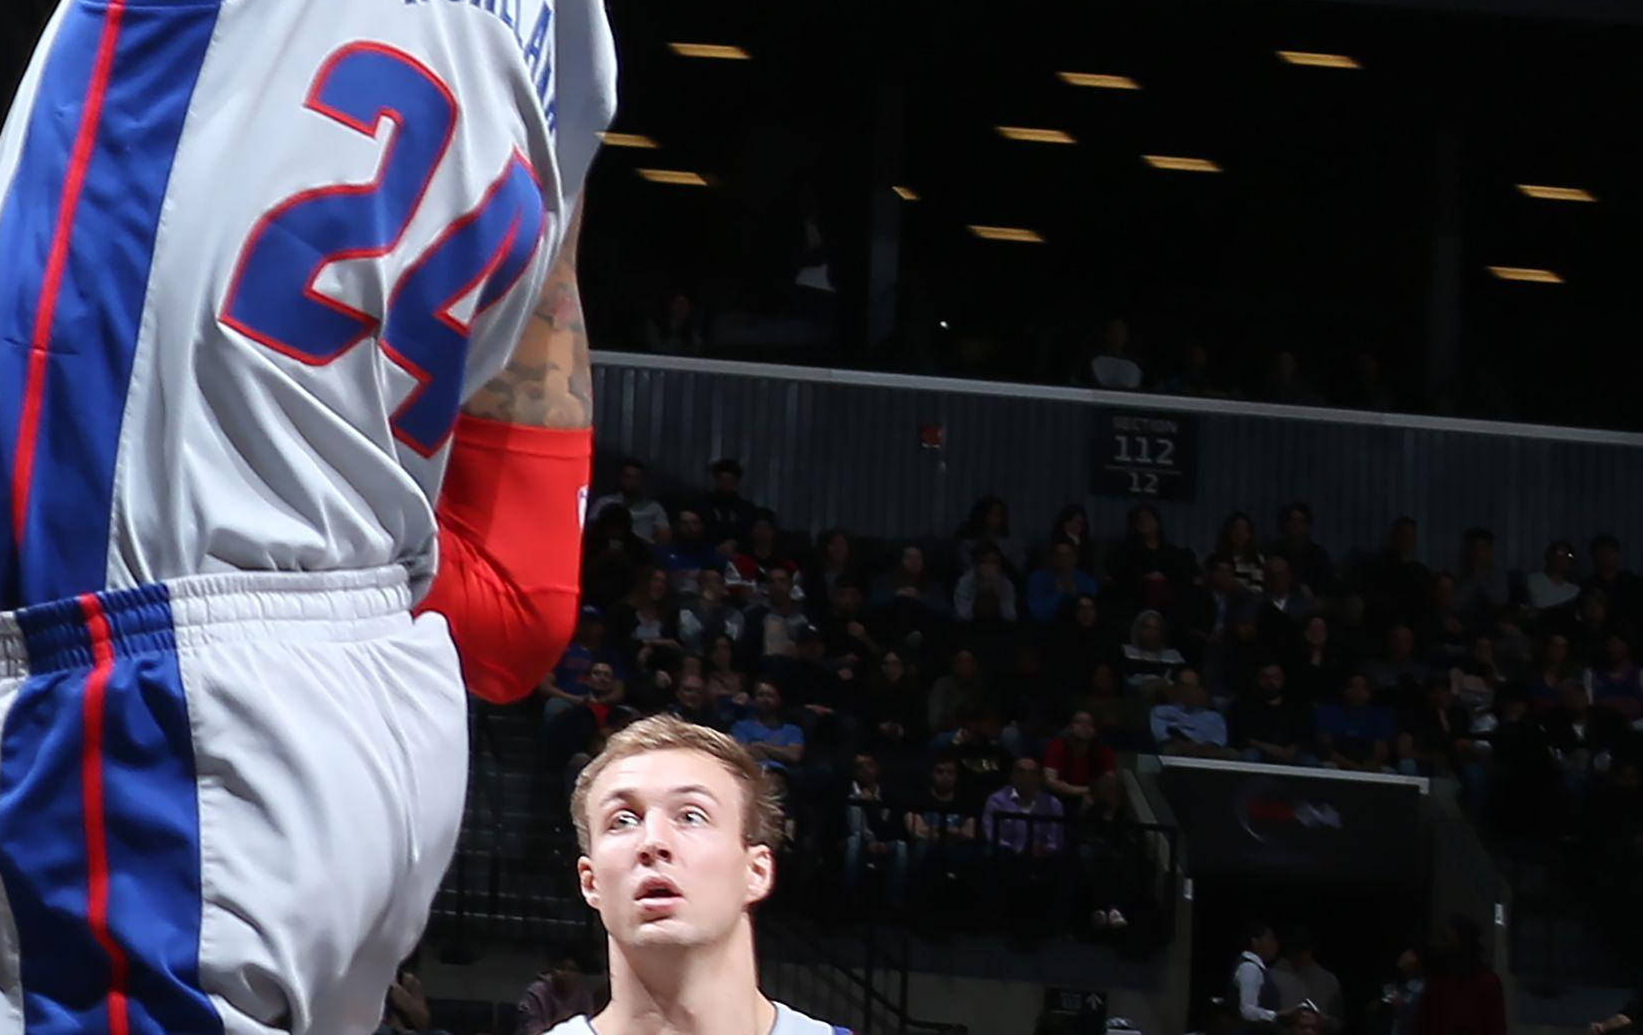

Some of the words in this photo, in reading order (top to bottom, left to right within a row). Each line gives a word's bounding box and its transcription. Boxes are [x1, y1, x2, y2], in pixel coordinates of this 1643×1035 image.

[217, 40, 546, 458] 24
[1114, 435, 1175, 466] 112
[1127, 472, 1159, 495] 12
